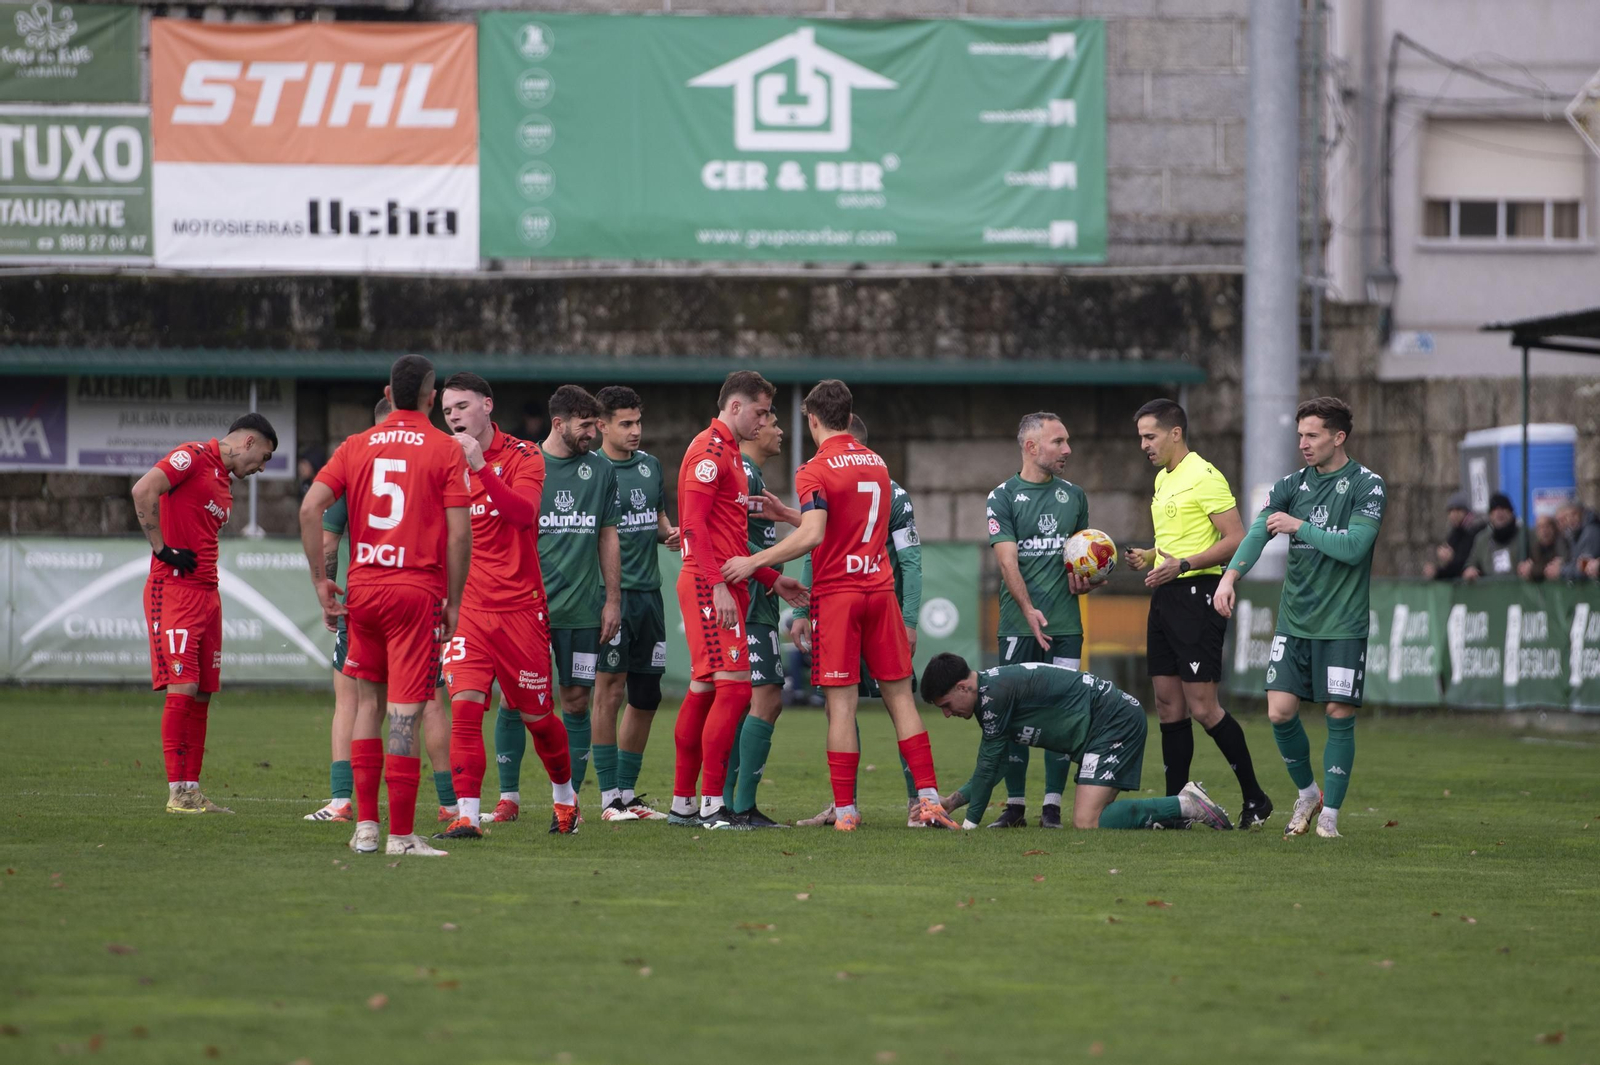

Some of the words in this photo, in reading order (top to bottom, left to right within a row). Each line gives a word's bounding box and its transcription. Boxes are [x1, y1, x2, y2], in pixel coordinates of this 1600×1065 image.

[172, 61, 458, 128] STIHL
[0, 125, 143, 183] TUXO
[702, 160, 769, 191] CER
[776, 160, 808, 191] &
[0, 199, 126, 228] TAURANTE
[173, 218, 304, 237] MOTOSIERRAS
[308, 199, 459, 236] Ucha
[175, 412, 233, 429] GARRIG
[368, 430, 425, 446] SANTOS
[368, 458, 406, 530] 5
[539, 511, 597, 527] olumbia
[857, 482, 881, 543] 7
[356, 542, 405, 568] DIGI
[166, 629, 188, 654] 17
[442, 636, 467, 666] 23
[1005, 636, 1018, 660] 7
[520, 669, 539, 678] Clínica
[574, 662, 595, 673] Barca
